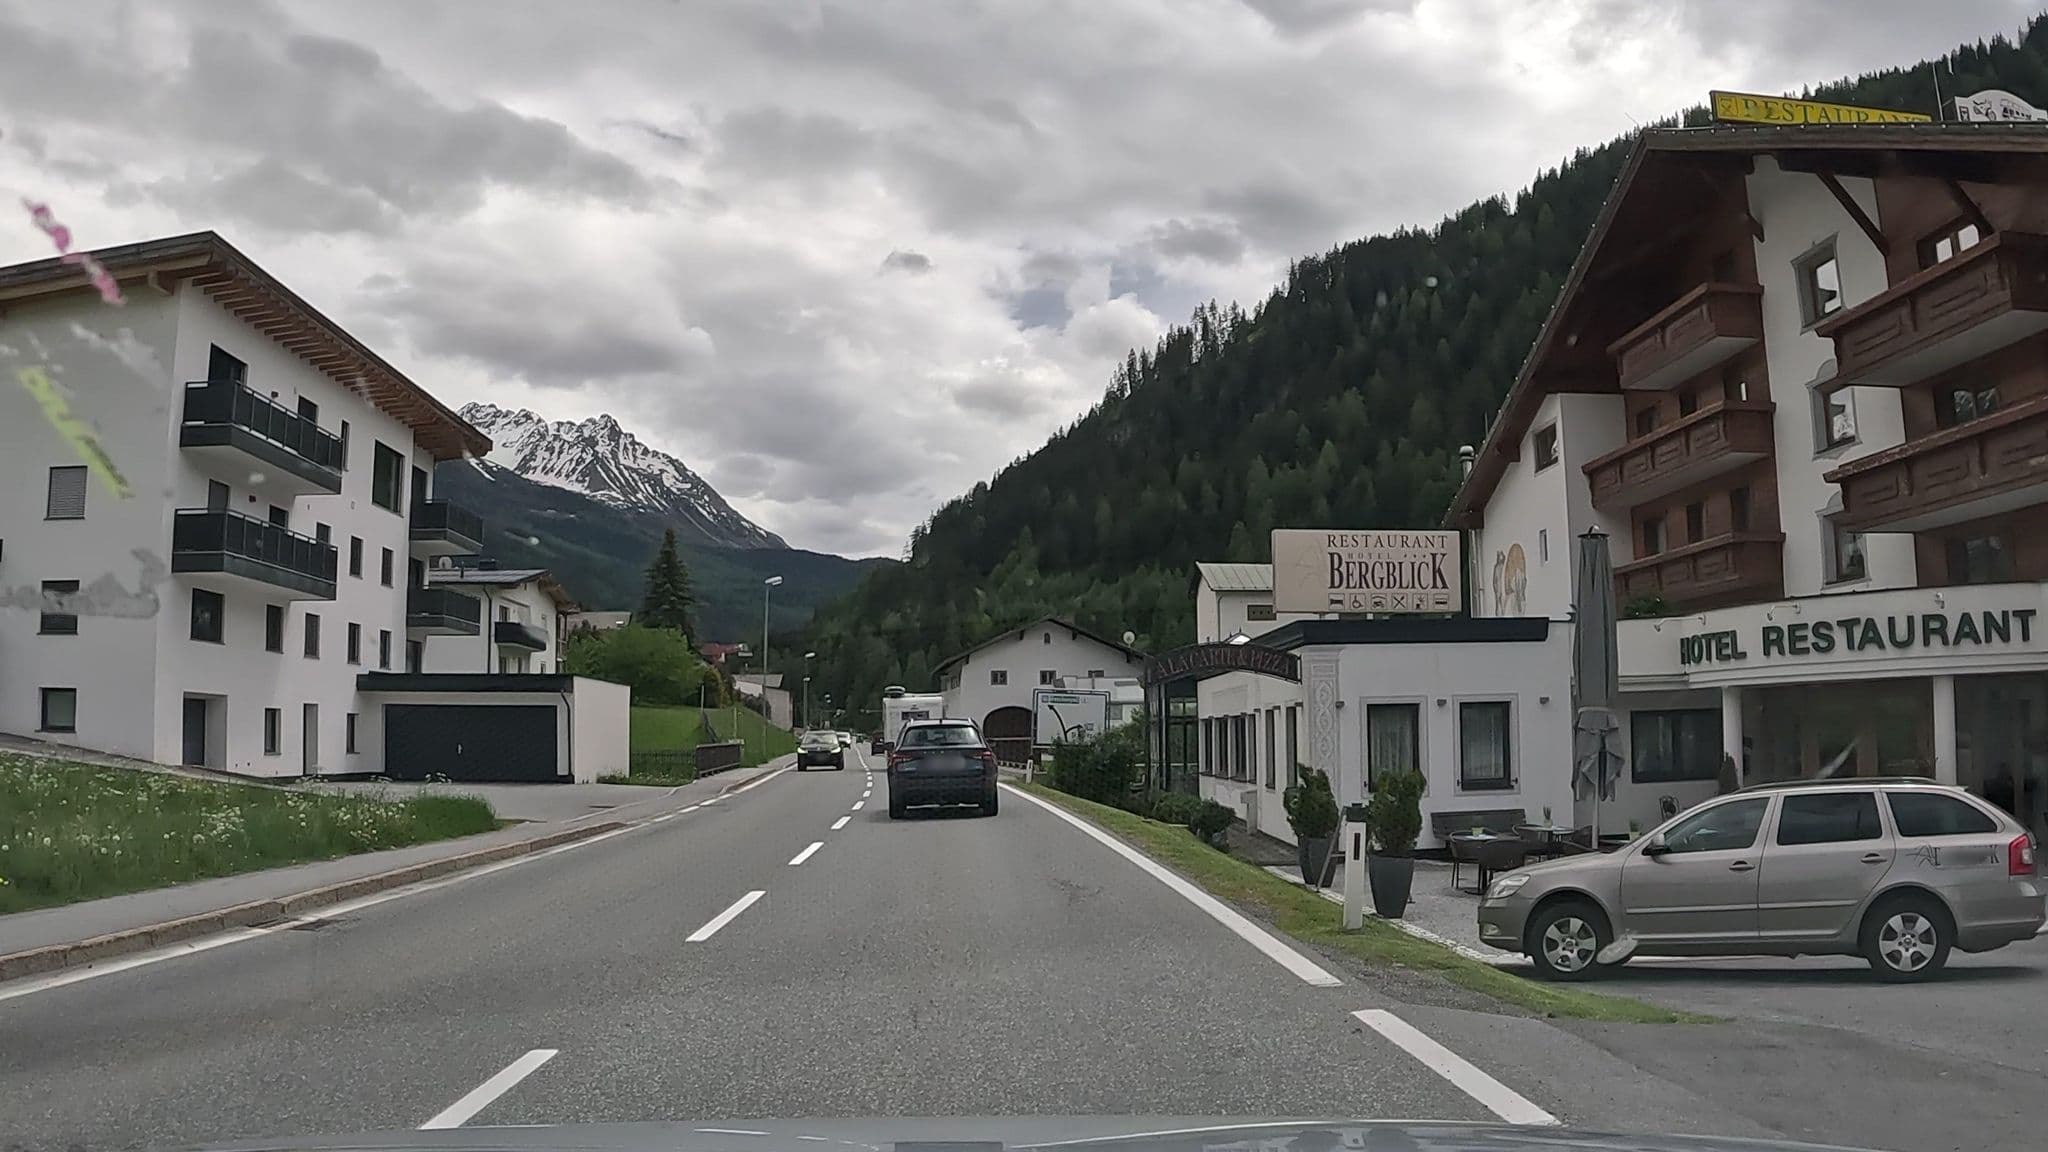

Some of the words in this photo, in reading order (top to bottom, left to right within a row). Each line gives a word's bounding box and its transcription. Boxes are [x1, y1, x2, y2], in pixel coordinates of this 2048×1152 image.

[1327, 534, 1448, 549] RESTAURANT
[1347, 552, 1392, 560] HOTEL
[1328, 552, 1450, 590] BERGBLICK
[1680, 629, 1747, 666] HOTEL
[1762, 608, 2037, 658] RESTAURANT
